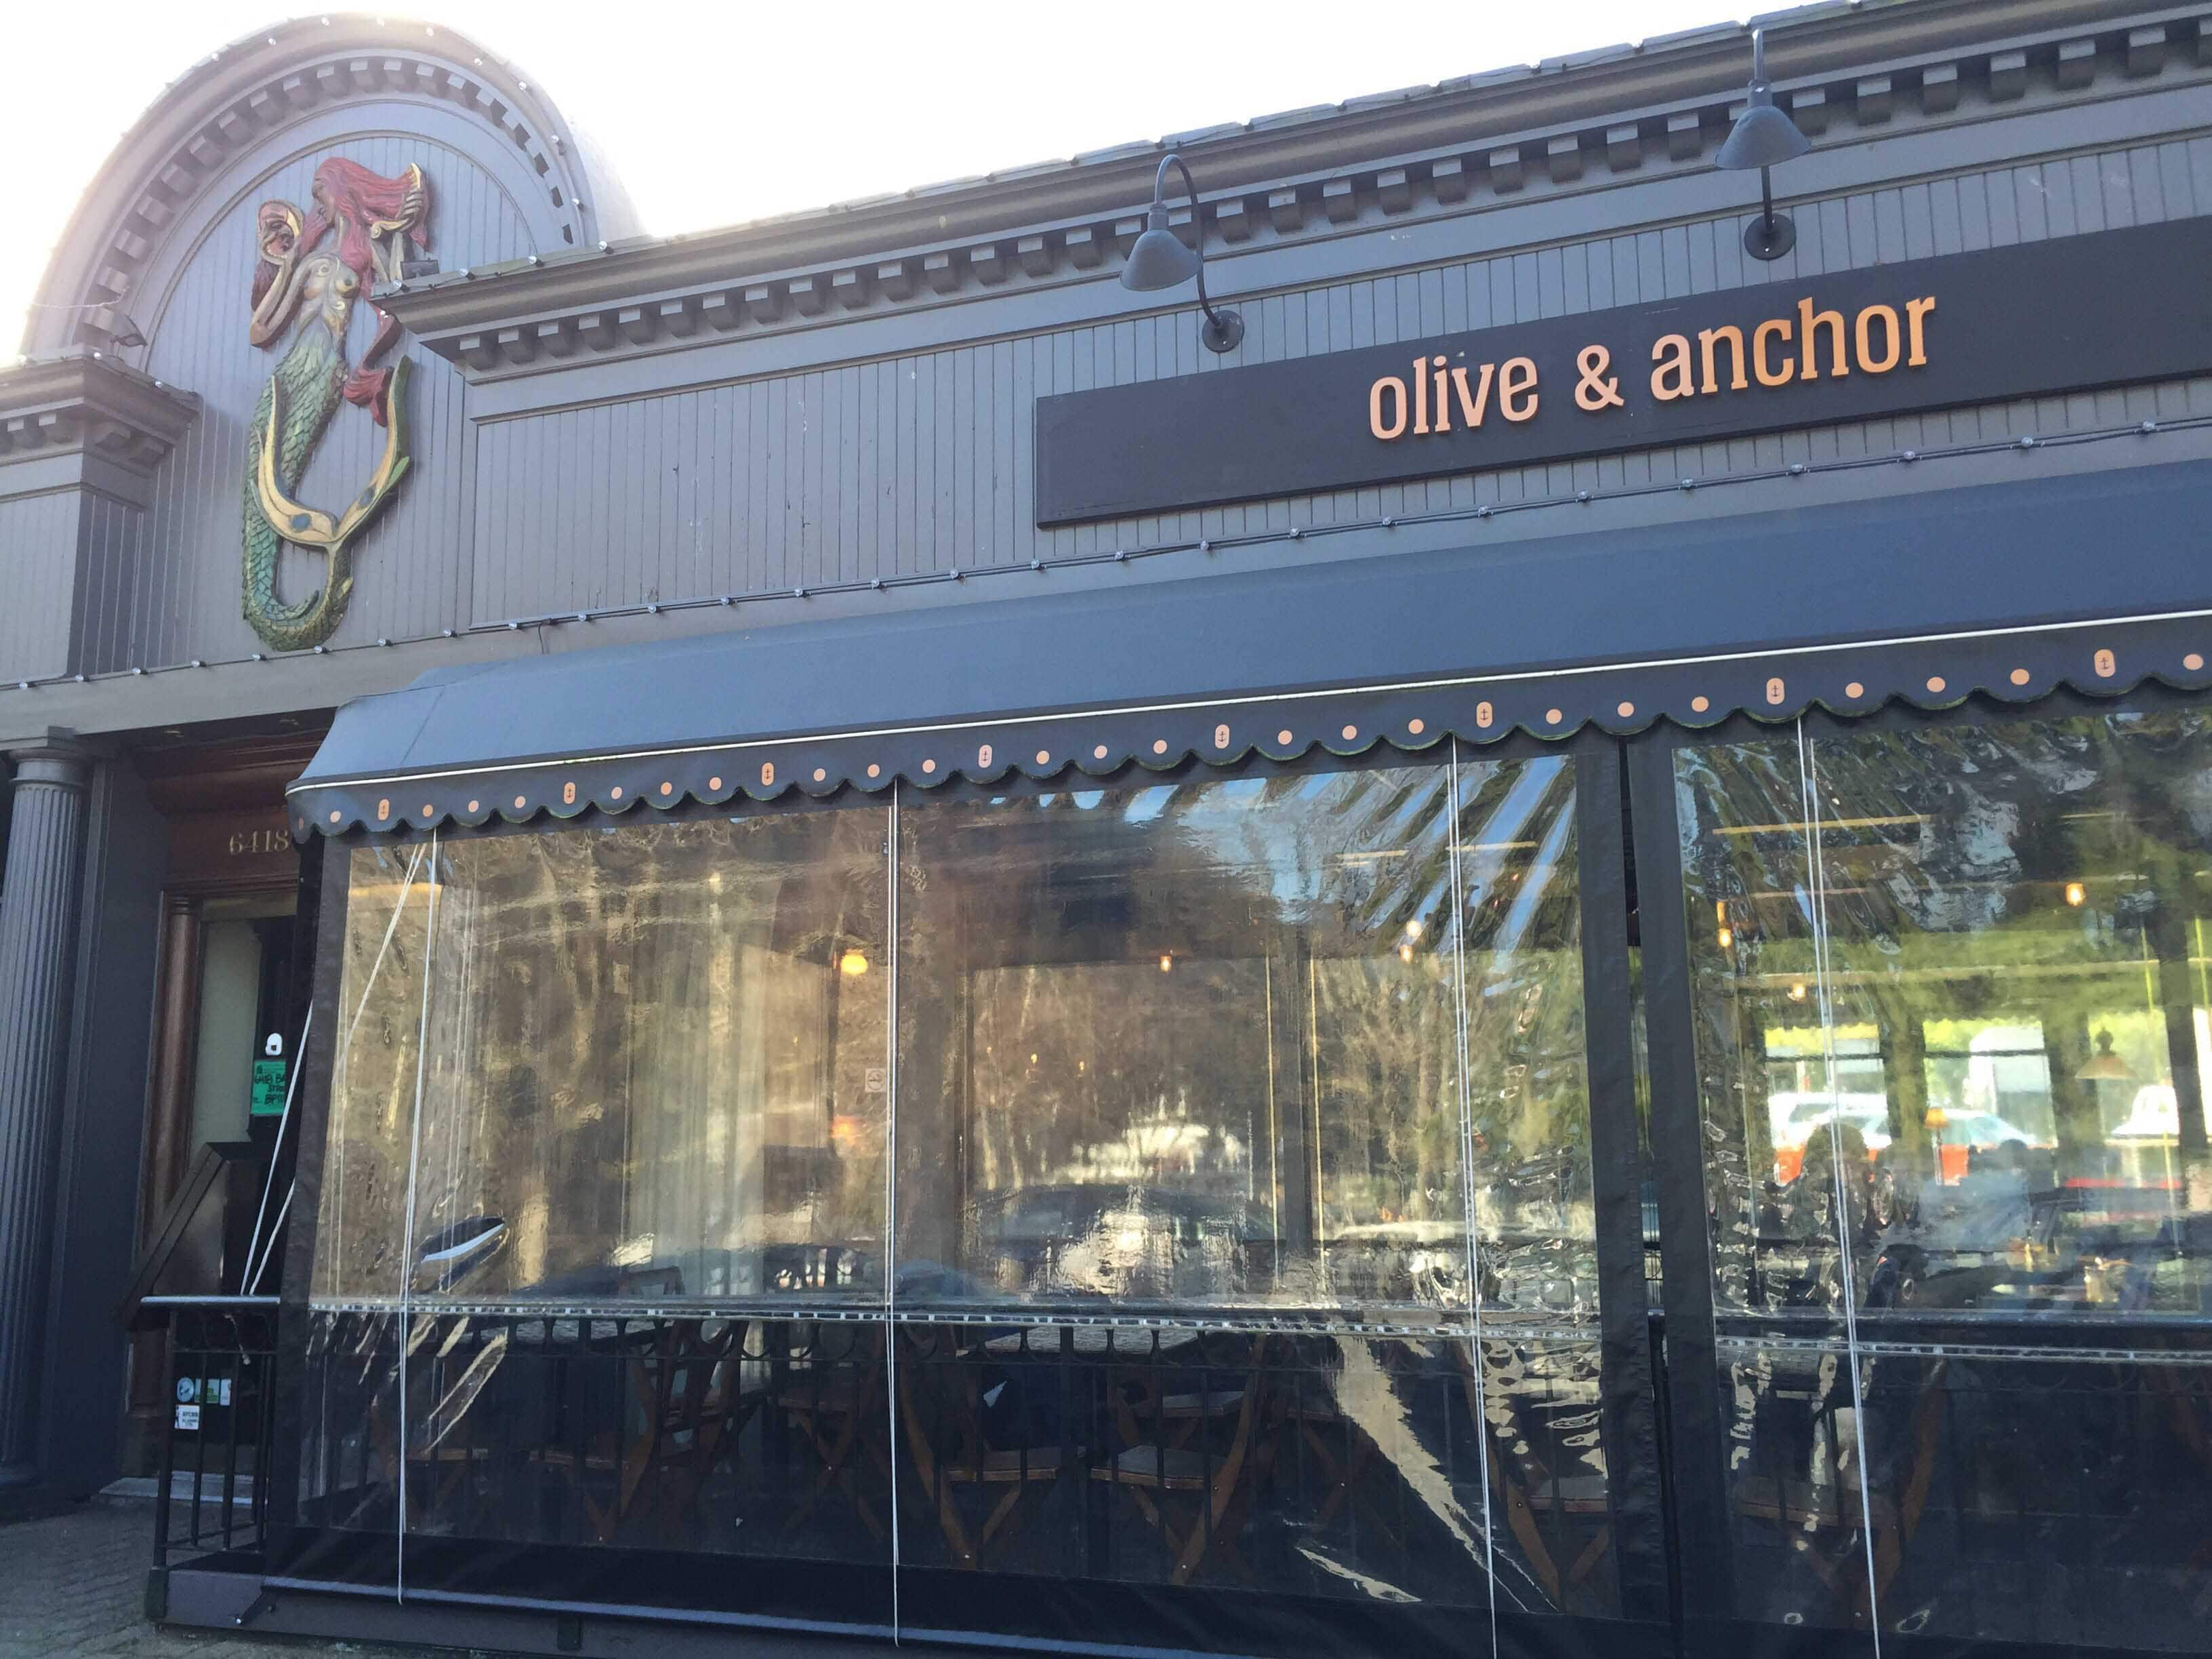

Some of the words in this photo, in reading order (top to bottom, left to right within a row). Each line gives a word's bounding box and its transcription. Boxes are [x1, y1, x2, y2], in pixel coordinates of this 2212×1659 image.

[1369, 355, 1539, 440] olive
[1574, 344, 1625, 411] &
[1650, 295, 1936, 401] anchor
[229, 830, 289, 855] 6418
